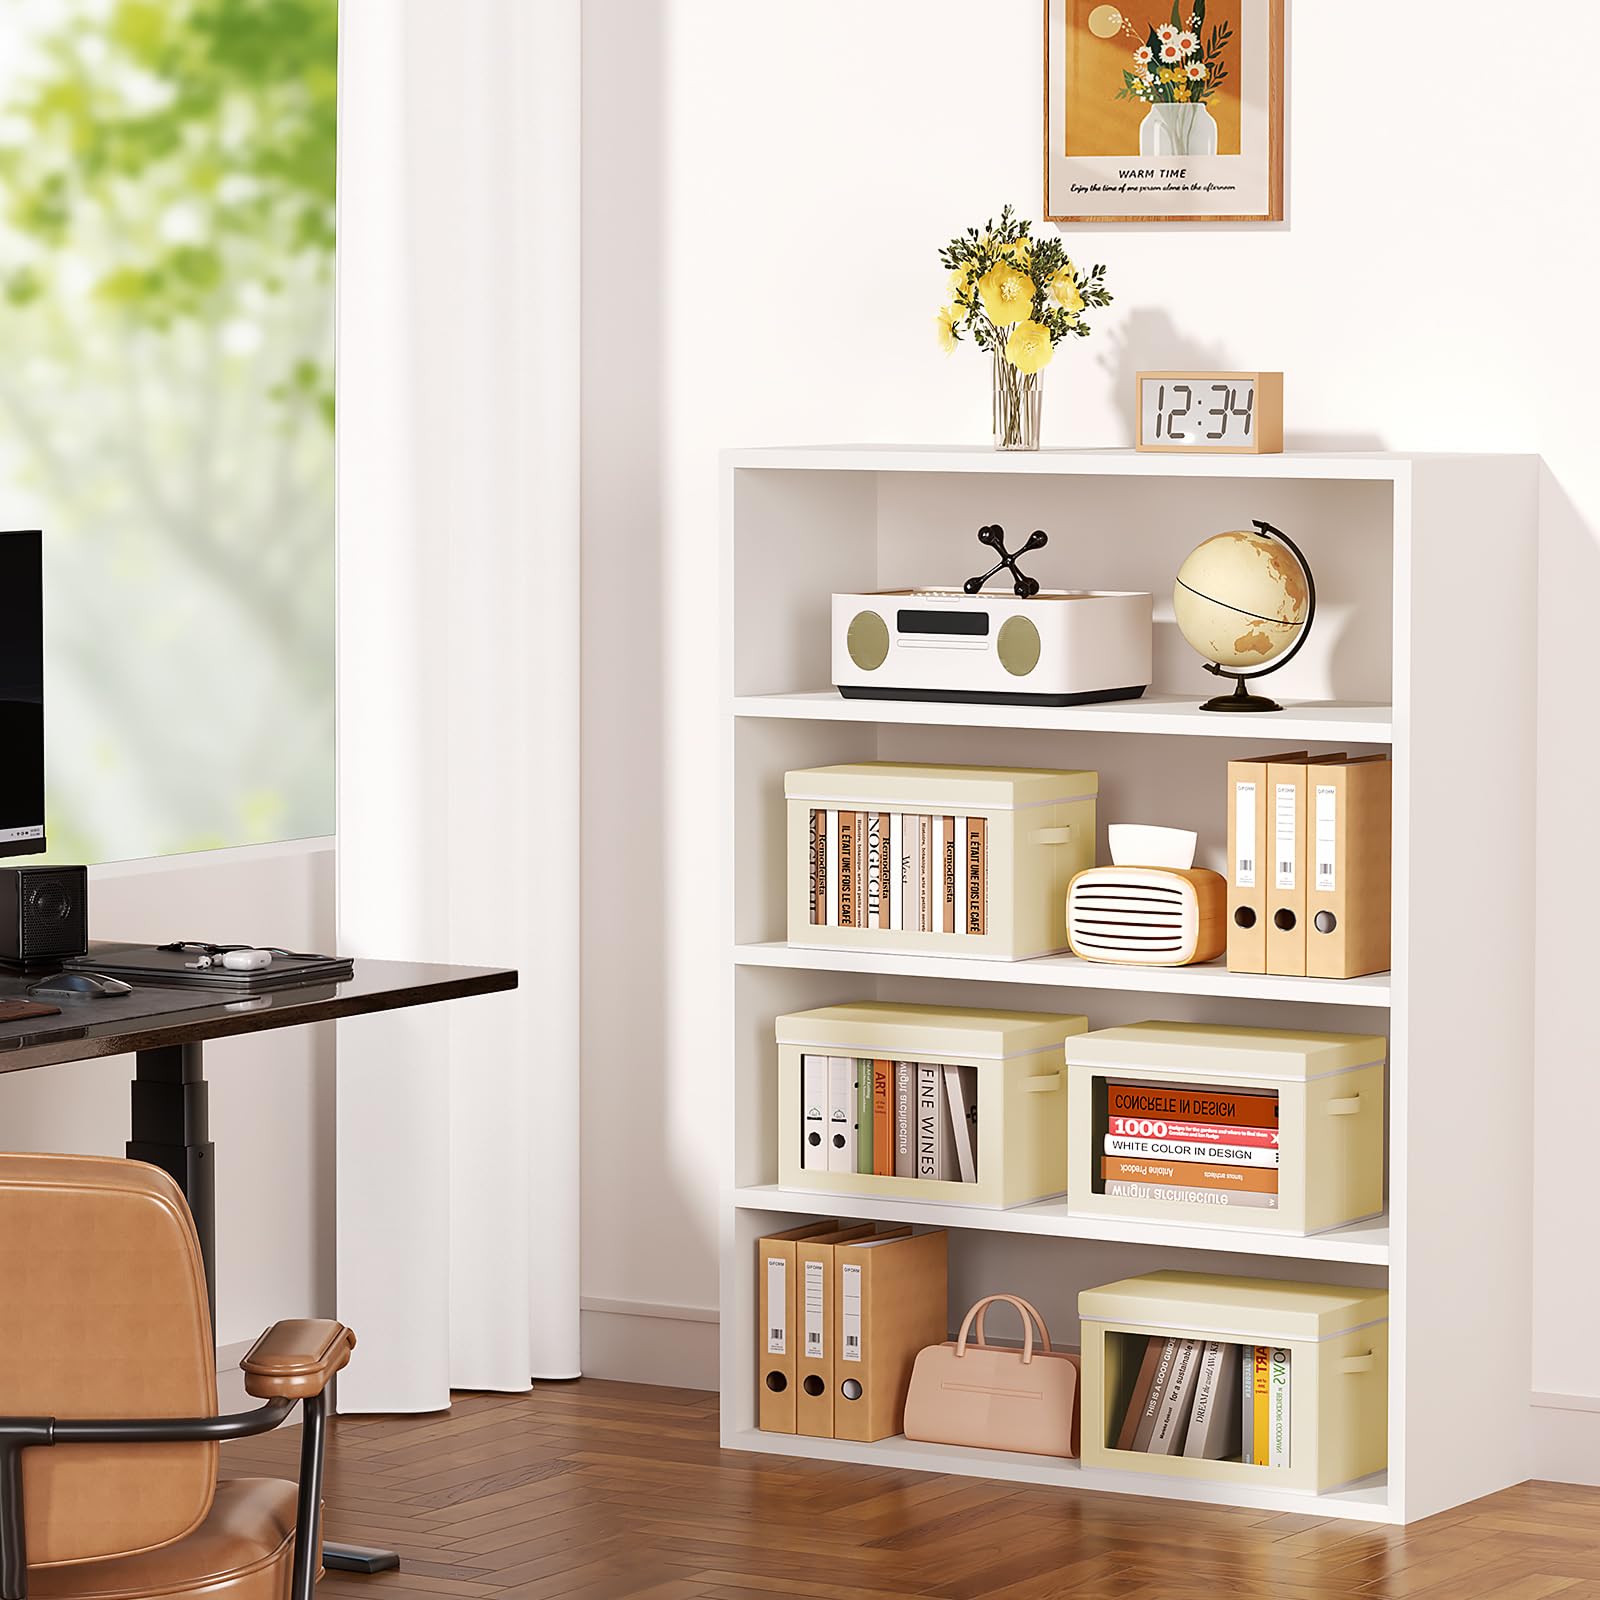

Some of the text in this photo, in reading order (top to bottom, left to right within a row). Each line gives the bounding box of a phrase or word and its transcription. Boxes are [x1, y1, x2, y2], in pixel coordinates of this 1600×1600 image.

[1118, 169, 1187, 179] WARM TIME
[1070, 183, 1089, 193] Enjoy
[1090, 183, 1101, 192] the
[1102, 183, 1118, 192] time
[1118, 183, 1127, 193] of
[1162, 184, 1180, 192] alone
[1181, 183, 1189, 191] in
[1190, 183, 1201, 191] the
[1203, 183, 1236, 193] afternoon
[1155, 384, 1254, 439] 12:34
[842, 834, 852, 856] ÉTAIT
[842, 857, 851, 873] UNE
[869, 818, 879, 914] NOGUCHI
[882, 837, 890, 899] Remodelista
[902, 855, 910, 884] West
[946, 841, 955, 903] Remodelista
[842, 875, 851, 892] FOIS
[971, 832, 981, 932] IL ÉTAIT UNE FOIS LE CAFÉ
[842, 893, 851, 903] LE
[842, 905, 852, 924] CAFÉ
[875, 1072, 886, 1096] ART
[921, 1069, 934, 1175] FINE WINES
[1114, 1119, 1167, 1138] 1000
[1112, 1140, 1252, 1160] WHITE COLOR IN DESIGN
[1120, 1163, 1174, 1177] Antoine Predock
[1157, 1361, 1169, 1384] GOOD
[1169, 1390, 1178, 1402] for
[1176, 1344, 1193, 1385] sustainable
[1152, 1391, 1159, 1400] IS
[1156, 1384, 1162, 1392] A
[1146, 1398, 1157, 1417] THIS
[1195, 1394, 1209, 1423] DREAM
